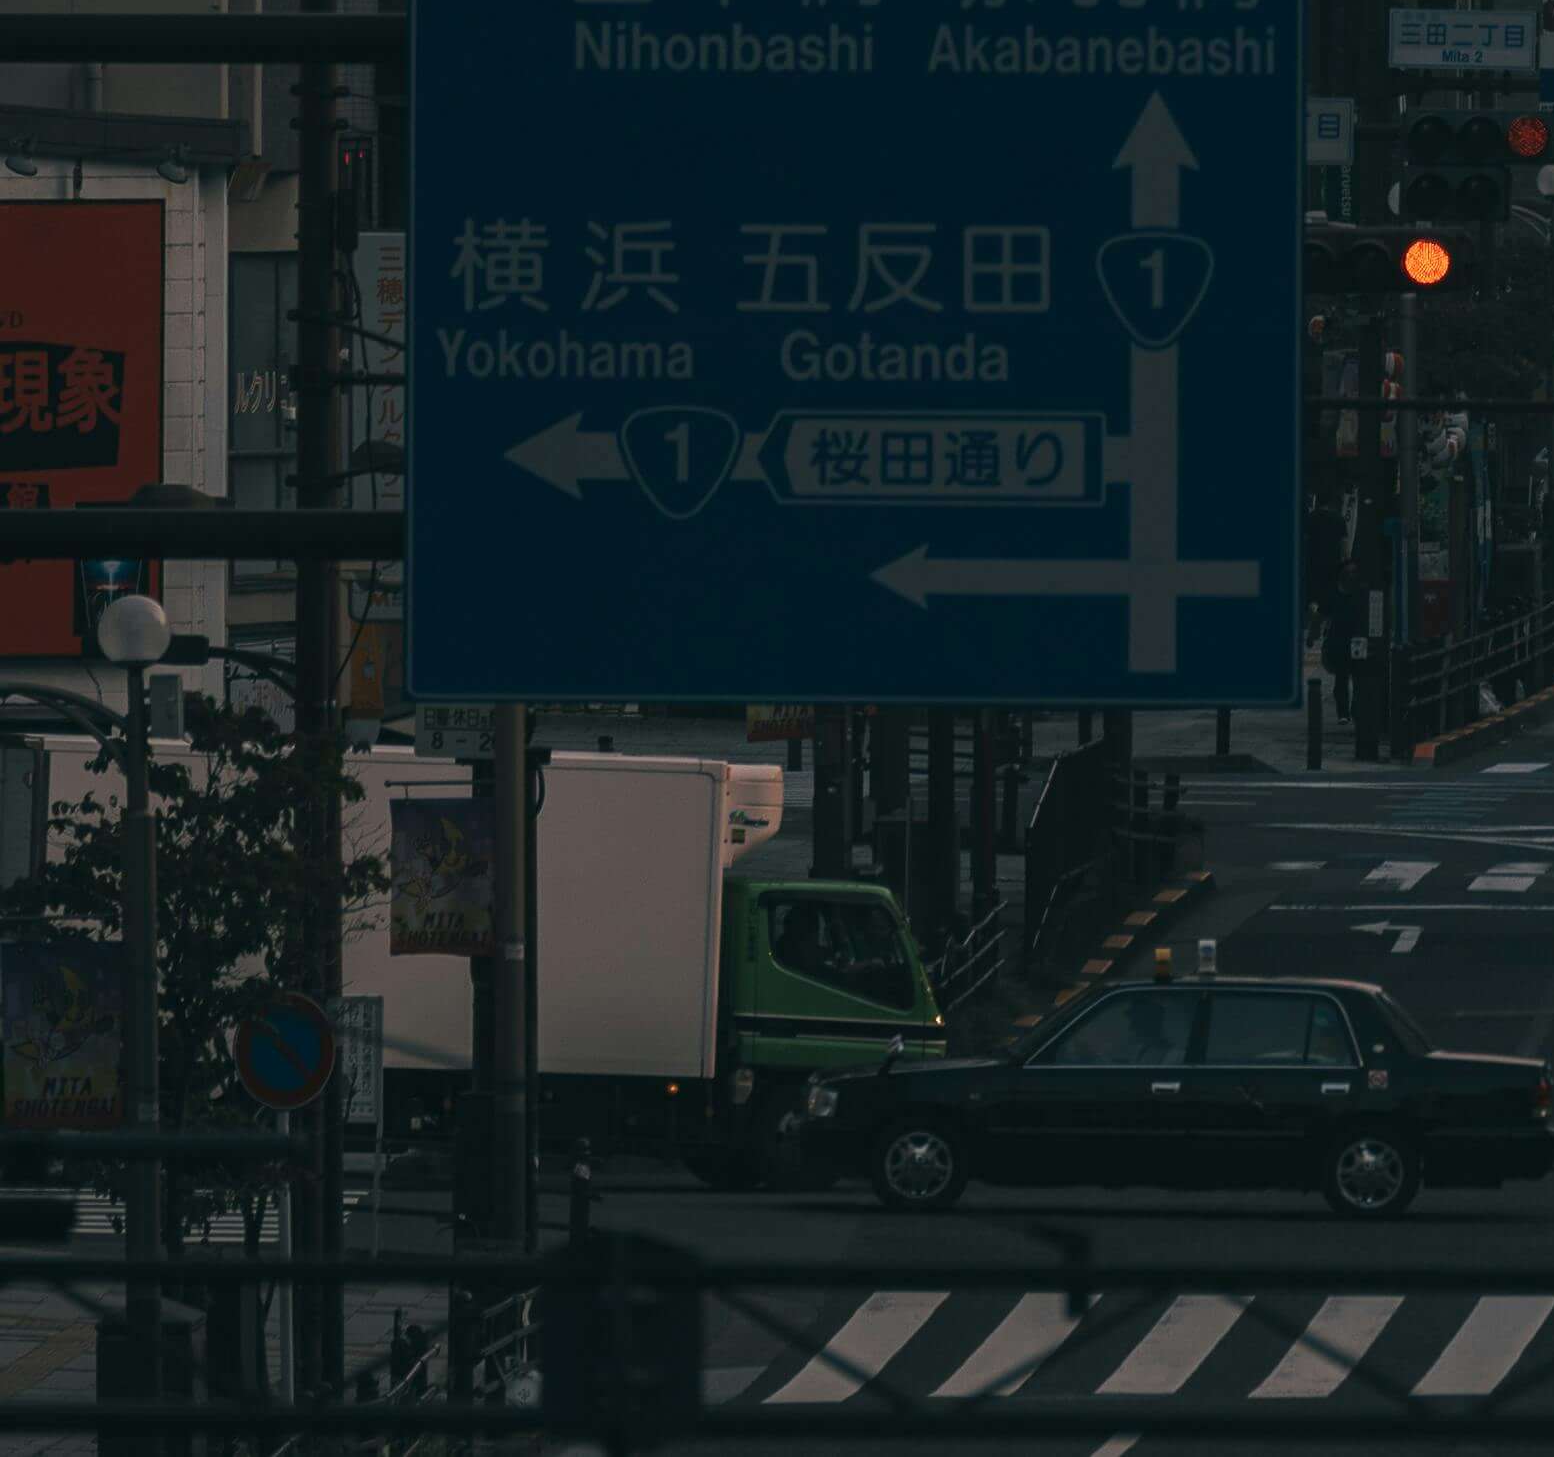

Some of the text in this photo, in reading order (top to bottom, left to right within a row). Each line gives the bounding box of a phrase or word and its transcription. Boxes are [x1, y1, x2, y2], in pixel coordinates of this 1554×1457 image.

[572, 23, 1278, 77] Nihonbashi Akabanebashi
[1399, 23, 1526, 48] 三田二丁目
[1441, 49, 1484, 63] Mita 2
[449, 217, 1053, 316] 横浜 五反田
[1138, 251, 1168, 310] 1
[437, 329, 1011, 383] Yokohama Gotanda
[0, 347, 120, 436] 現象
[664, 423, 691, 483] 1
[811, 431, 1065, 488] 桜田通り
[430, 731, 444, 750] 8
[422, 911, 466, 929] MITA
[13, 1097, 119, 1119] SHOTENGAI
[43, 1076, 95, 1096] MITA
